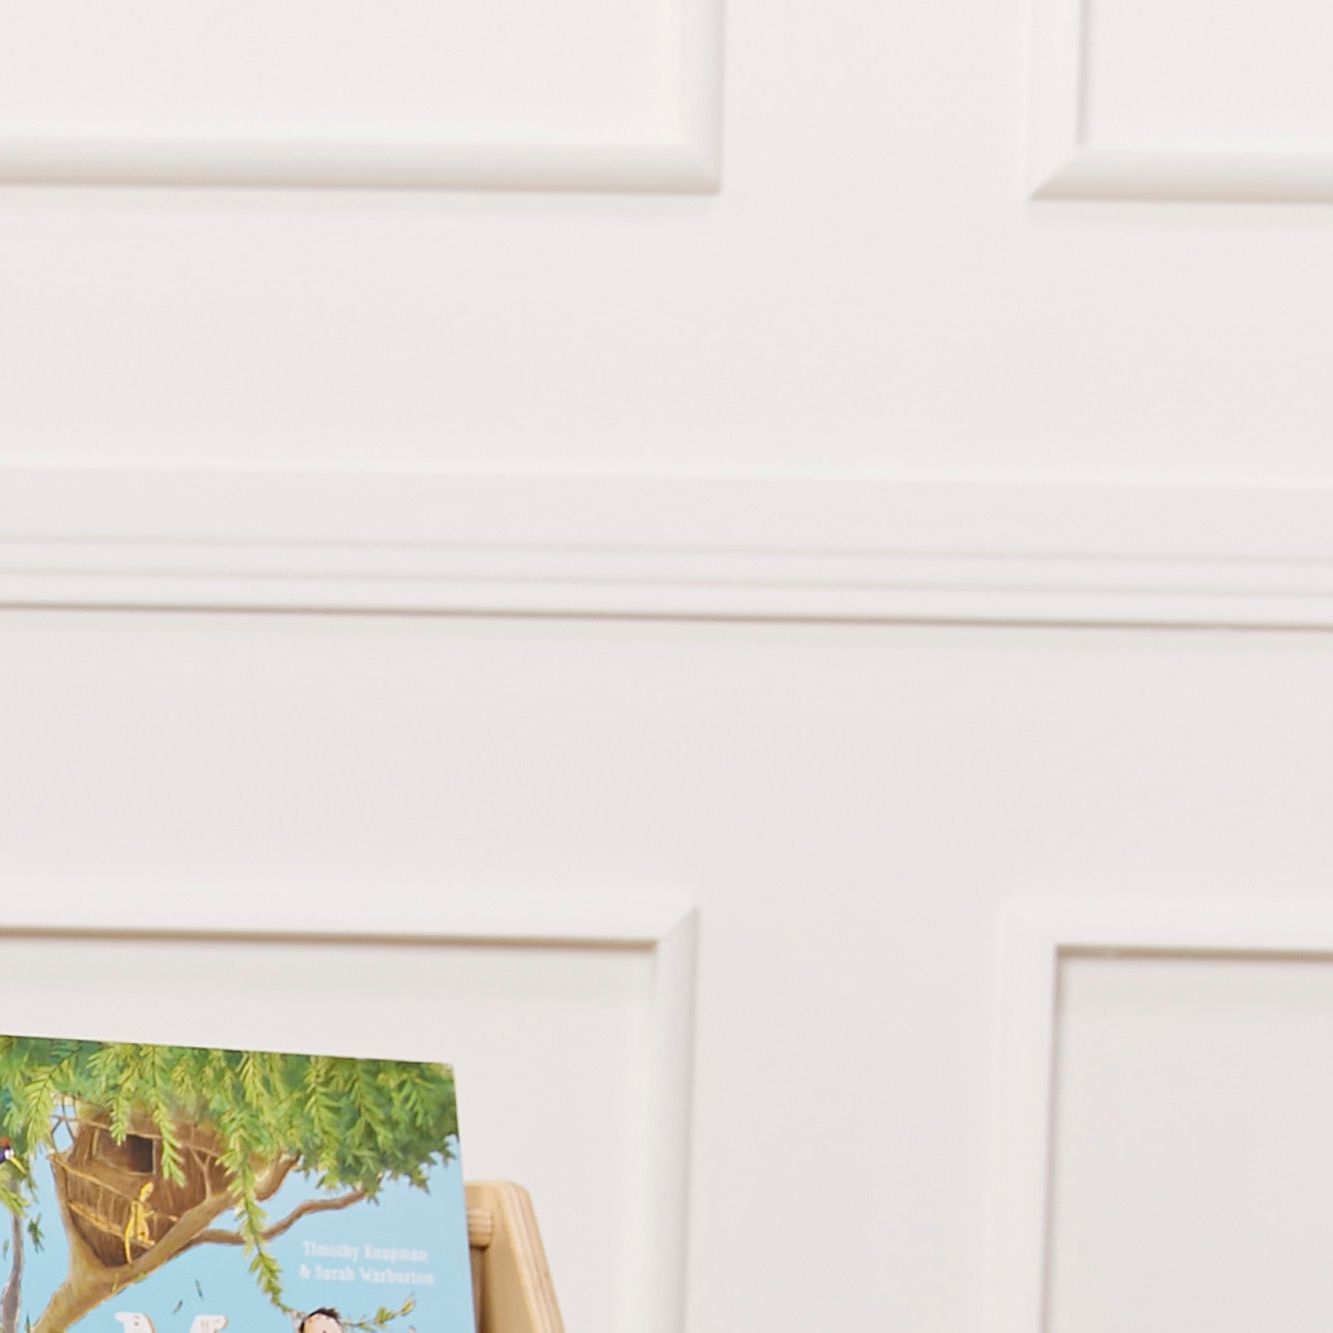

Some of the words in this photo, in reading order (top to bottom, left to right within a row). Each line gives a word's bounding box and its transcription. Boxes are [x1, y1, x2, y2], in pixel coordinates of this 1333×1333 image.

[301, 1239, 360, 1263] Timothy
[299, 1264, 311, 1279] &
[315, 1265, 355, 1281] Sarah
[359, 1266, 435, 1285] Warburton
